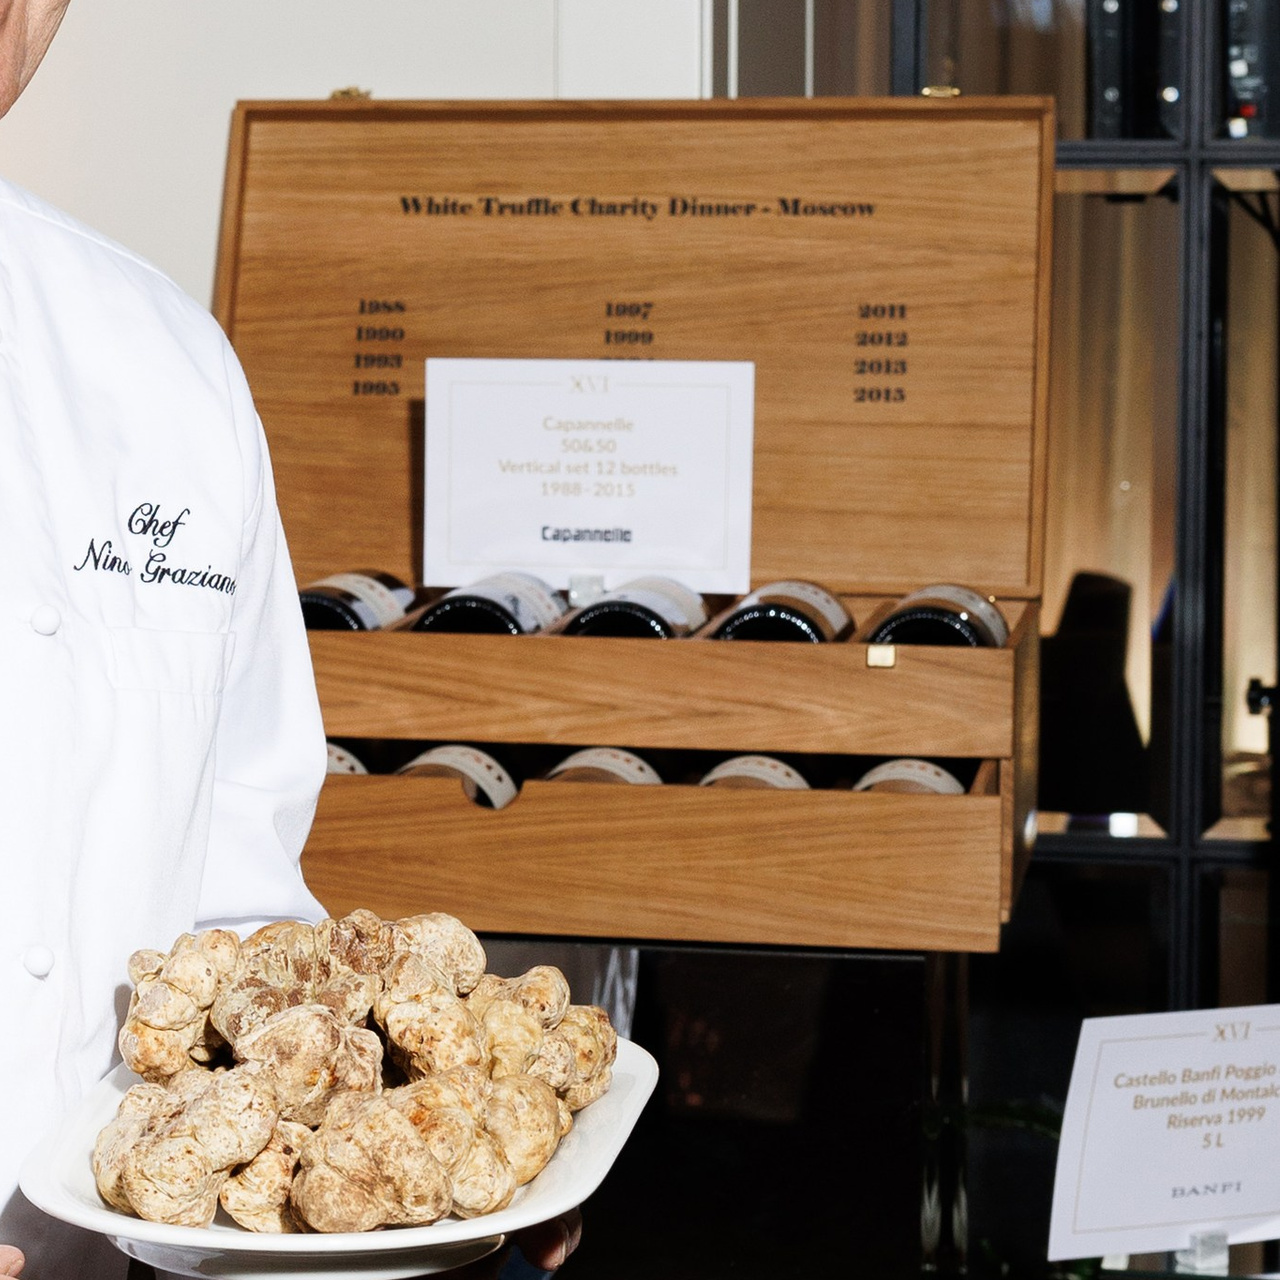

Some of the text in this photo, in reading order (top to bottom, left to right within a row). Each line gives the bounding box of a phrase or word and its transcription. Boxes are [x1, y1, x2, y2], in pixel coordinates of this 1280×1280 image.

[400, 196, 472, 217] White
[478, 196, 562, 217] Truffle
[570, 196, 658, 220] Charity
[669, 197, 755, 217] Dinner
[777, 197, 875, 217] Moscow
[605, 302, 654, 320] 1997
[858, 304, 907, 319] 2011
[856, 331, 908, 347] 2012
[853, 359, 907, 375] 2013
[569, 375, 610, 393] XVI
[853, 387, 905, 403] 2015
[541, 417, 635, 433] Capannelle
[497, 458, 678, 477] Vertical set 12 bottles
[127, 502, 191, 548] Chef
[540, 525, 633, 544] Capannelle
[1113, 1063, 1277, 1089] Castello Banfi Poggio
[1133, 1091, 1198, 1110] Brunello
[1201, 1088, 1217, 1105] di
[1167, 1107, 1265, 1130] Riserva 1999
[1172, 1181, 1241, 1198] BANFI
